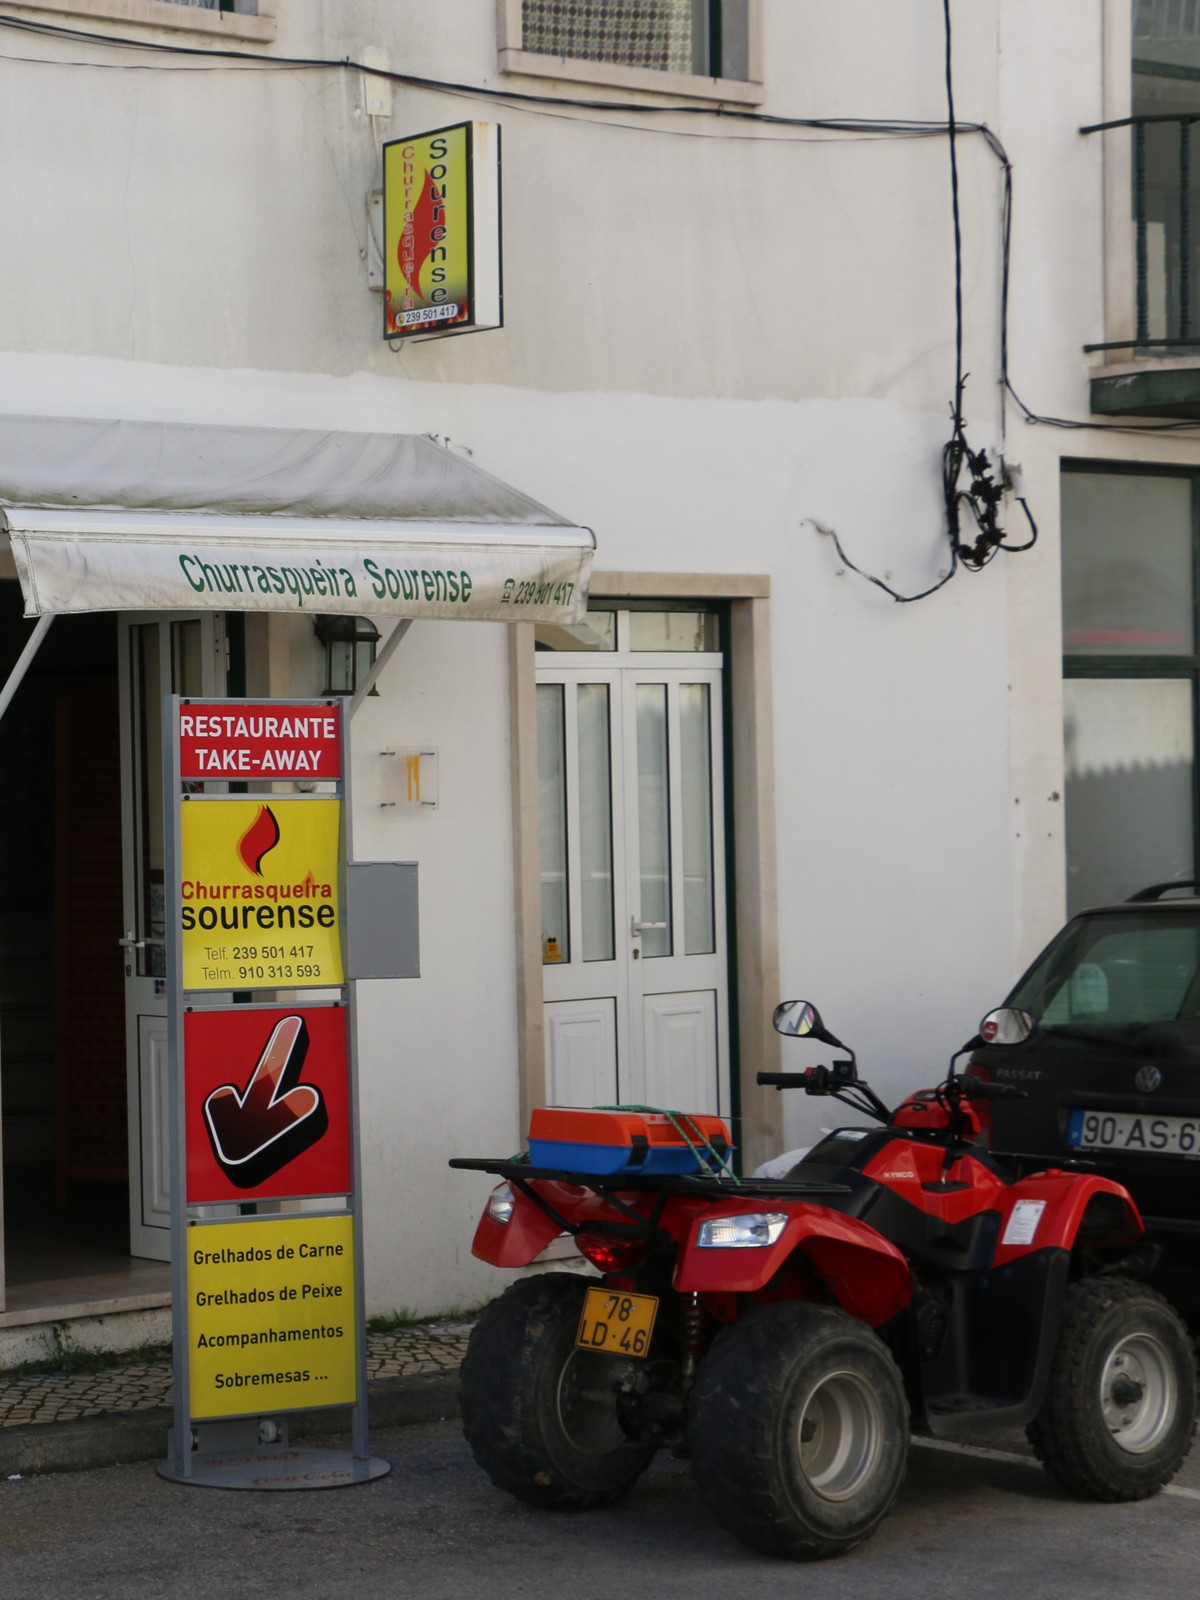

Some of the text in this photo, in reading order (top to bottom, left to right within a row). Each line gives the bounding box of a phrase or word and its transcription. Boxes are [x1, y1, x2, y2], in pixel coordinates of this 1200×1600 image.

[401, 145, 416, 310] Churrasqueira
[429, 137, 448, 303] Sourense
[405, 304, 456, 324] 239 501 417
[178, 553, 357, 607] Churrasqueira
[363, 558, 473, 603] Sourense
[513, 580, 536, 605] 239
[553, 581, 575, 606] 417
[180, 715, 336, 739] RESTAURANTE
[195, 748, 322, 771] TAKE-AWAY
[181, 876, 332, 903] Churrasqueira
[182, 904, 335, 930] sourense
[204, 945, 314, 960] Telf. 239 501 417
[202, 964, 321, 980] Telm. 910 313 593
[996, 1068, 1042, 1080] PASSAT
[193, 1243, 344, 1265] Grelhados de Carne
[196, 1283, 343, 1307] Grelhados de Peixe
[607, 1295, 632, 1322] 78
[197, 1325, 344, 1349] Acompanhamentos
[215, 1370, 310, 1389] Sobremesas
